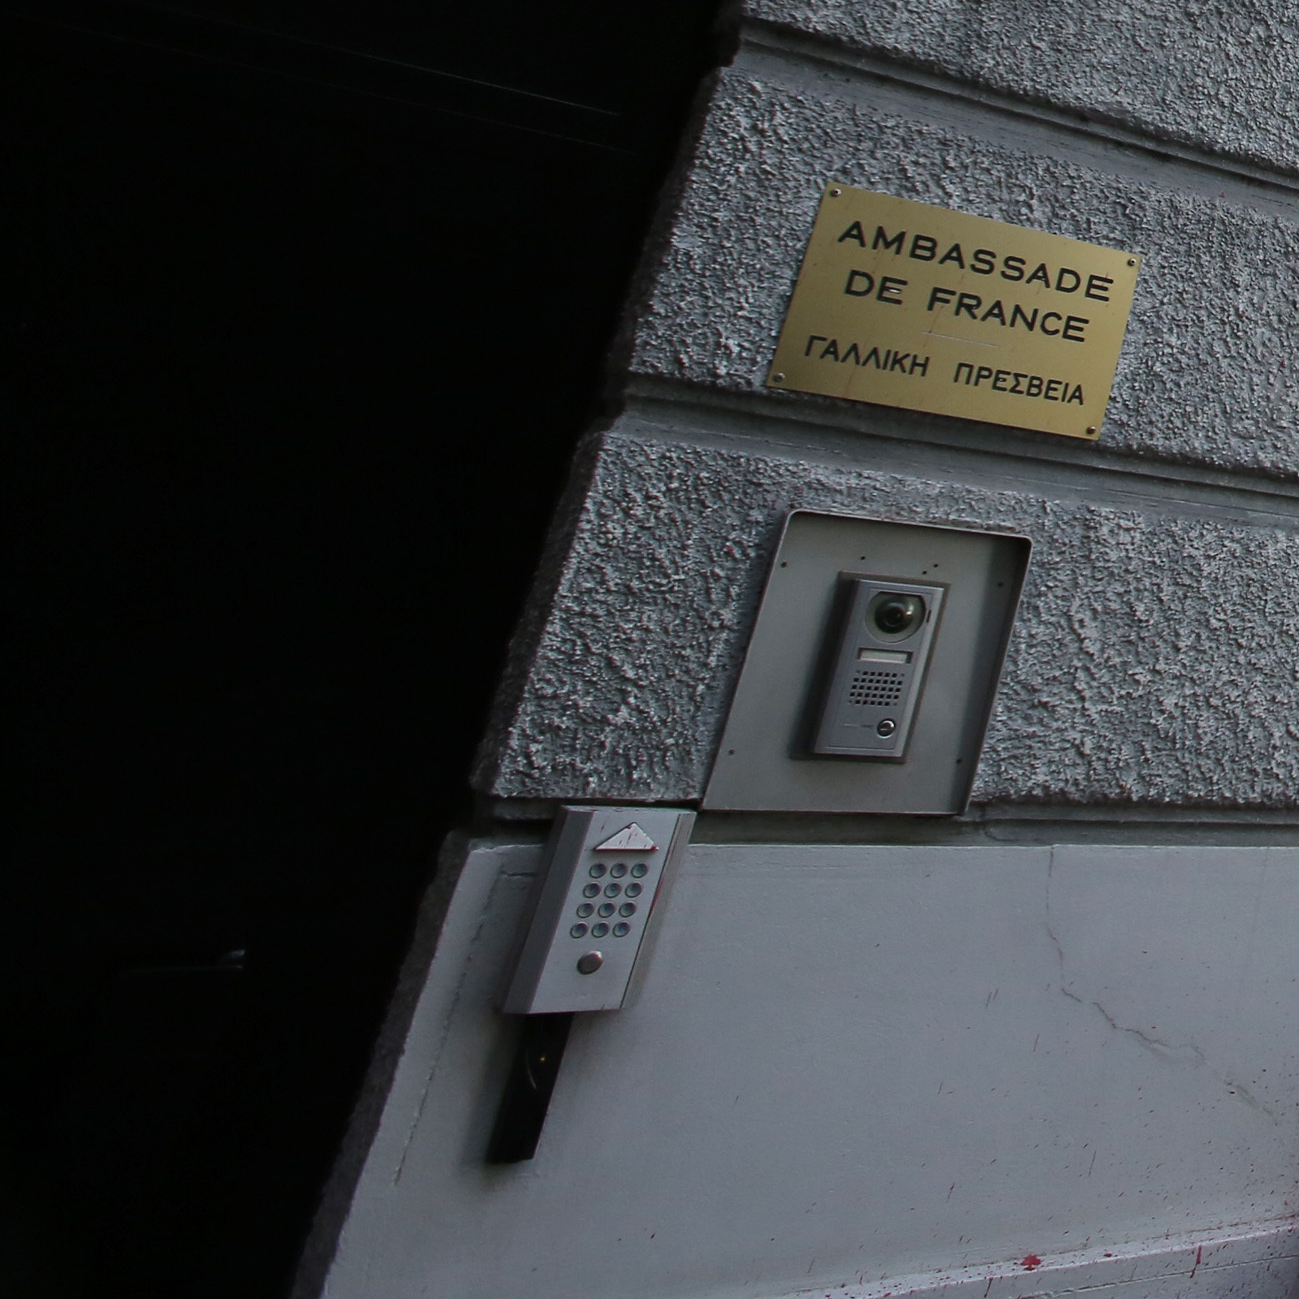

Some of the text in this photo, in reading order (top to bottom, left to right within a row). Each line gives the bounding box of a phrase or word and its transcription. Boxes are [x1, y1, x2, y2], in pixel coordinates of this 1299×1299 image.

[837, 220, 1115, 303] AMBASSADE
[843, 269, 1090, 343] DE FRANCE
[804, 334, 1085, 406] ΓΑΛΛΙΚΗ ΠΡΕΣΒΕΙΑ
